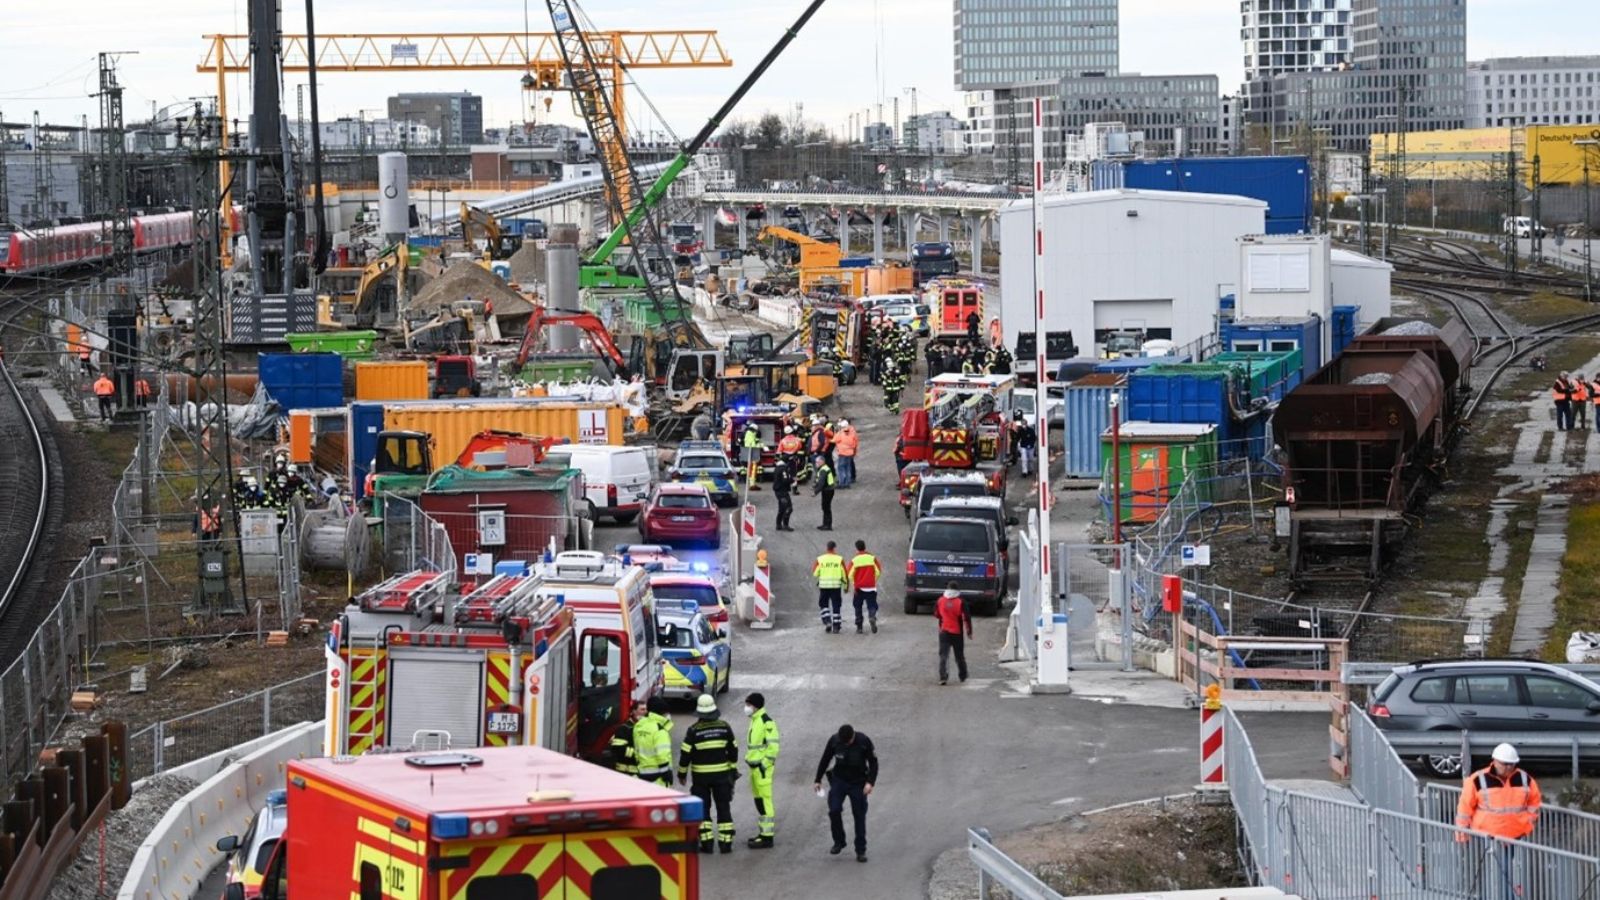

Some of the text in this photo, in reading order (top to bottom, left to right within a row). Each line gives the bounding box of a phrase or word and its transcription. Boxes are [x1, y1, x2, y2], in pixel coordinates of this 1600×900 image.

[1540, 132, 1588, 142] Deutsche Post
[497, 721, 517, 731] 1175
[391, 865, 405, 892] 112
